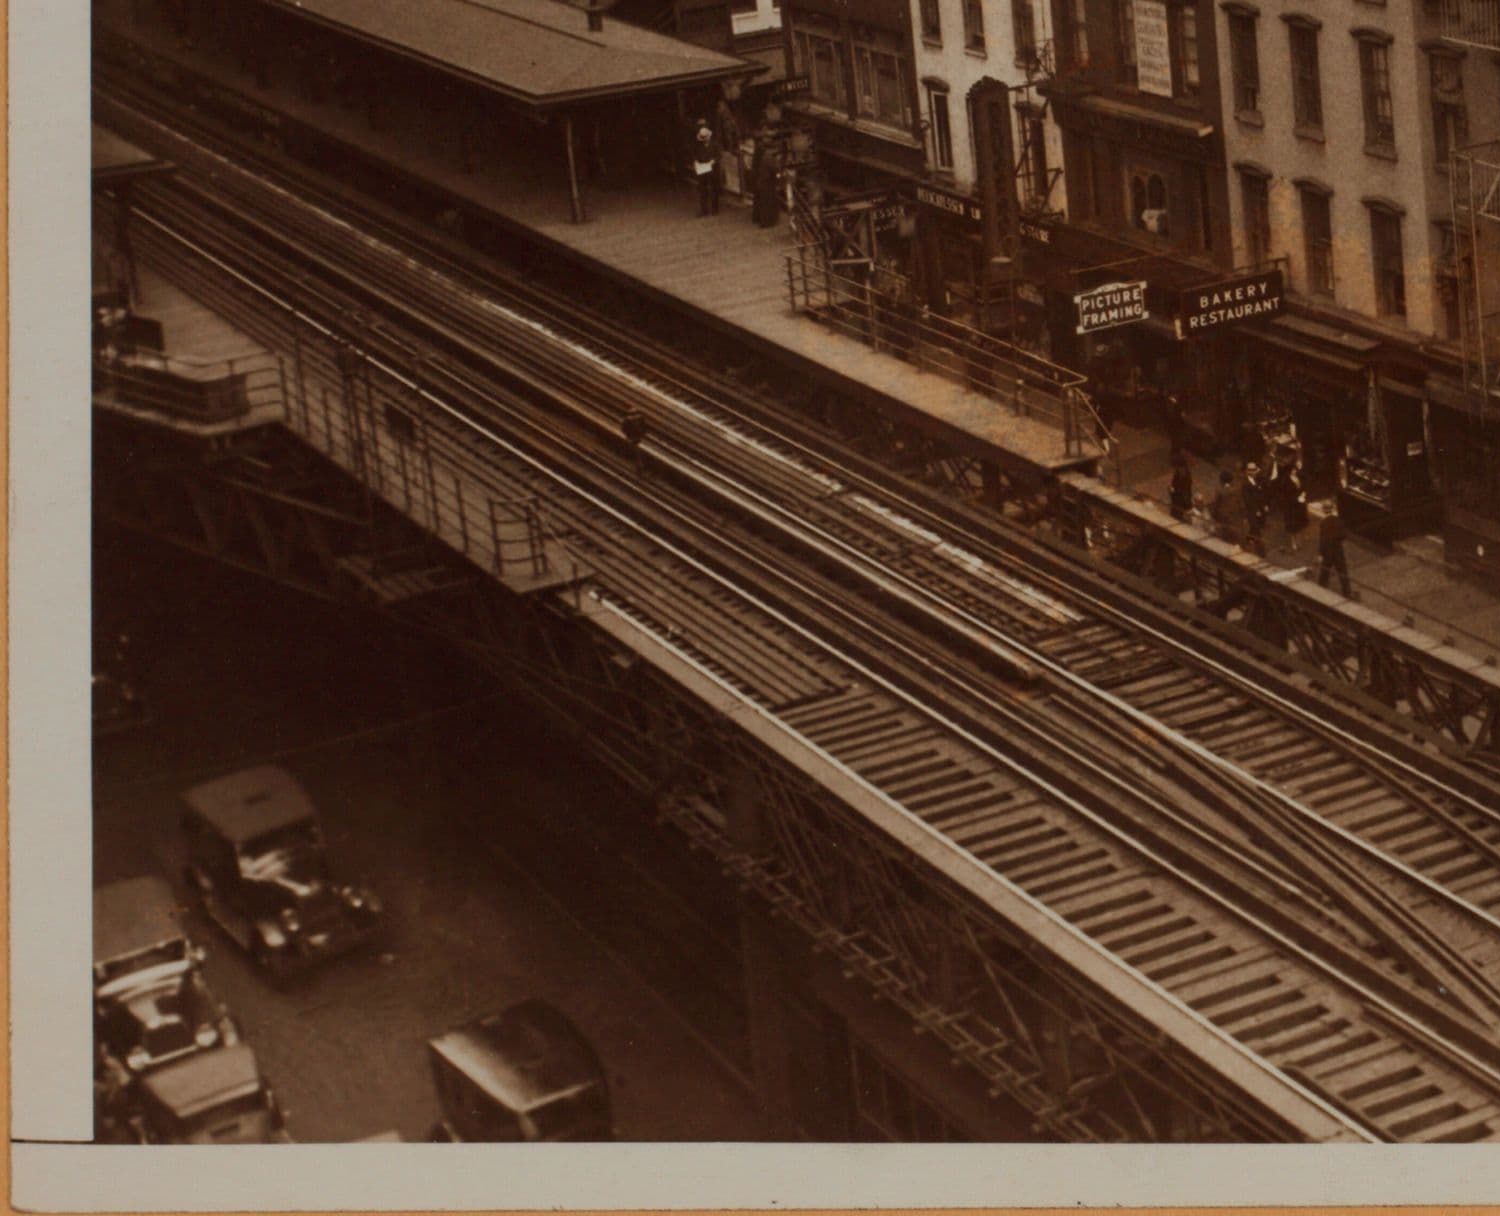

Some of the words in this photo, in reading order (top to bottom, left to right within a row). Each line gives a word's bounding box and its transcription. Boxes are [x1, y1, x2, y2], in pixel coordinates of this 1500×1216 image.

[1082, 288, 1141, 311] PICTURE
[1199, 282, 1268, 309] BAKERY
[1082, 303, 1141, 327] FRAMING
[1189, 297, 1280, 329] RESTAURANT
